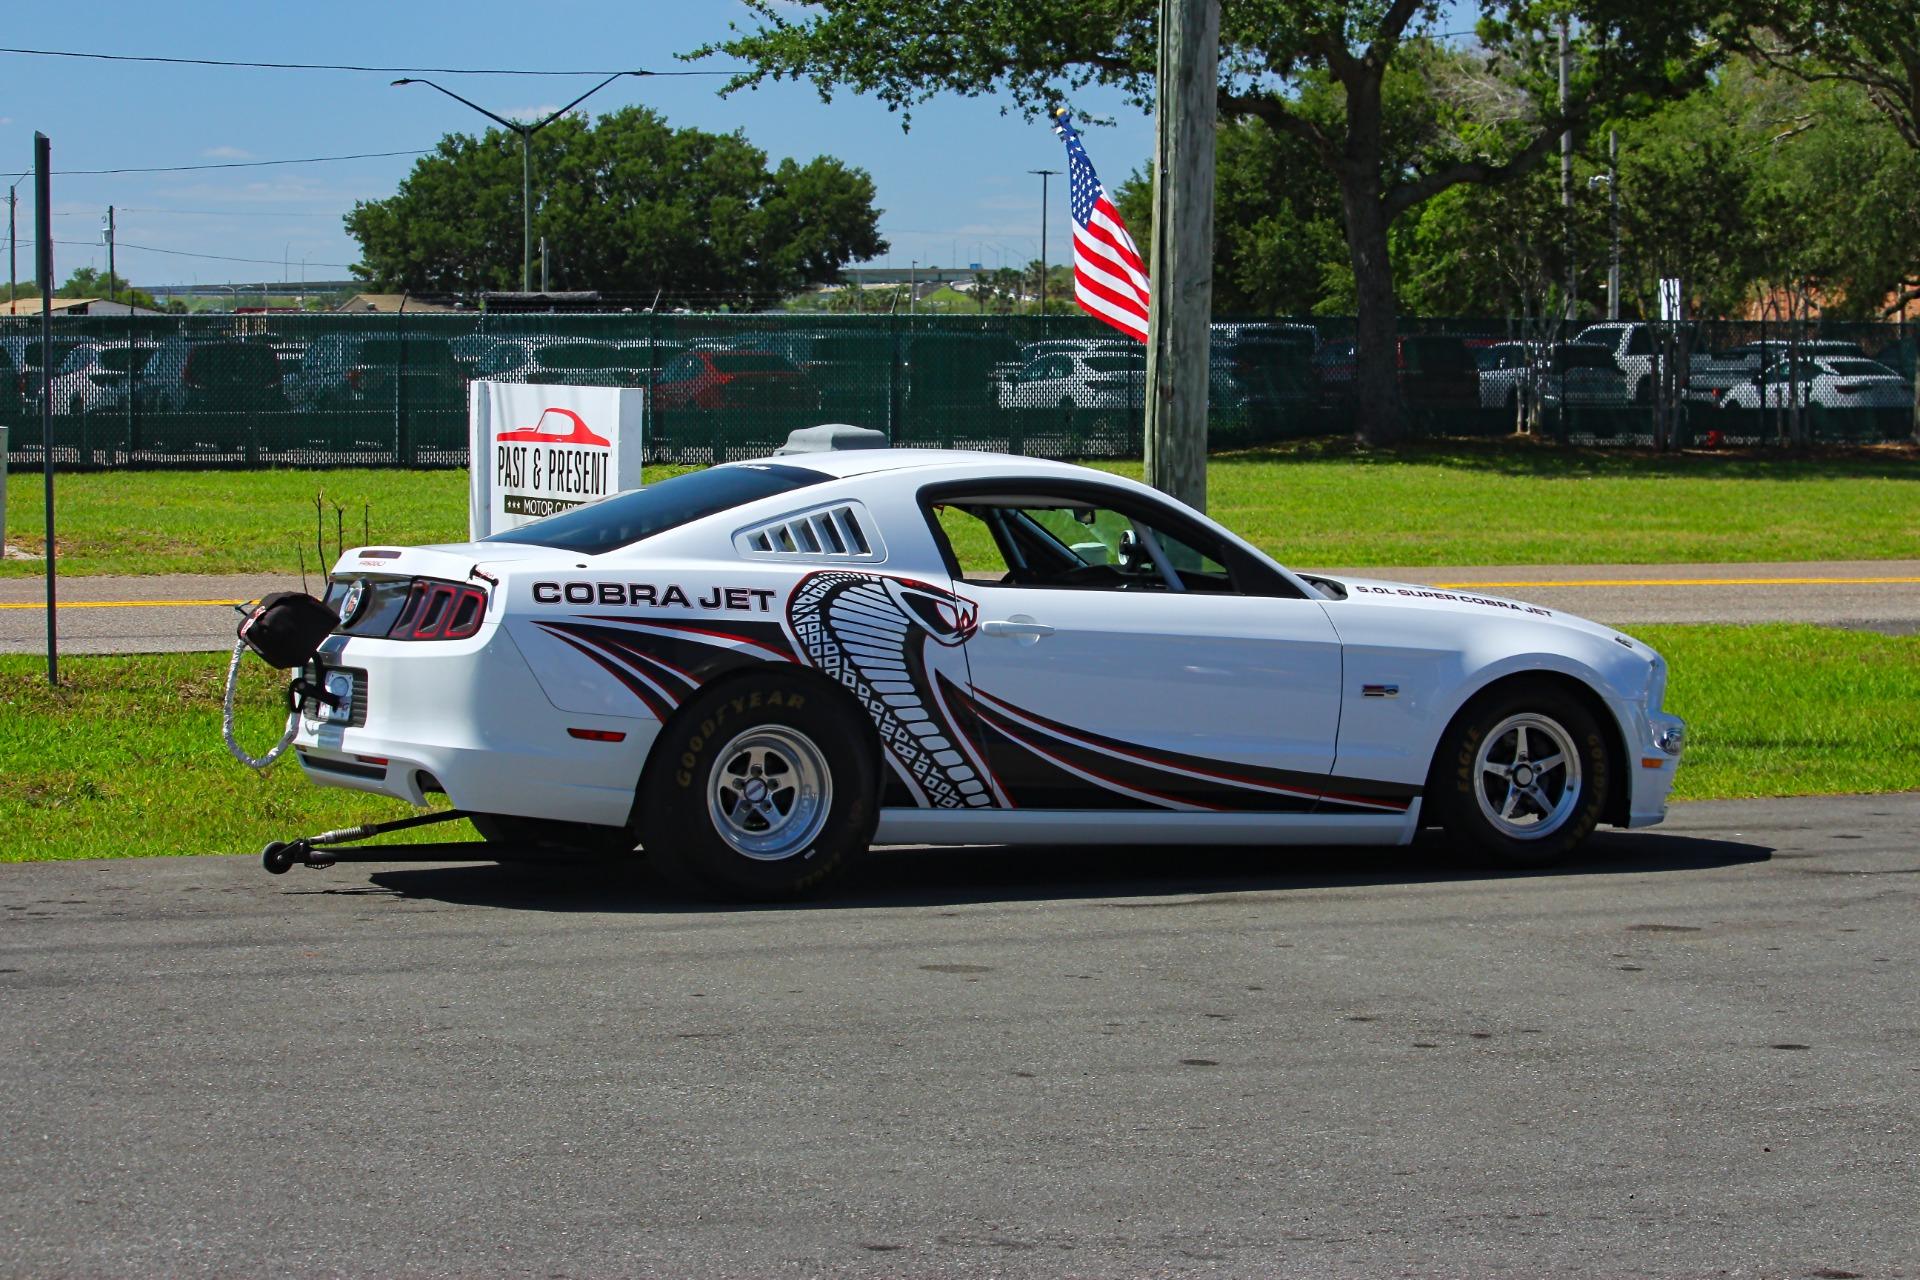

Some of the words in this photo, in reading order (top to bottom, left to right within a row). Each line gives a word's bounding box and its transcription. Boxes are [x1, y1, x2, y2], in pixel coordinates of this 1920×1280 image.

[498, 445, 527, 488] PAST
[533, 447, 541, 490] &
[549, 449, 609, 495] PRESENT
[523, 499, 554, 515] MOTOR
[532, 581, 694, 609] COBRA
[698, 586, 776, 612] JET
[1356, 586, 1396, 595] 5.0L
[1397, 589, 1458, 602] SUPER
[1459, 595, 1522, 611] COBRA
[1525, 606, 1553, 617] JET
